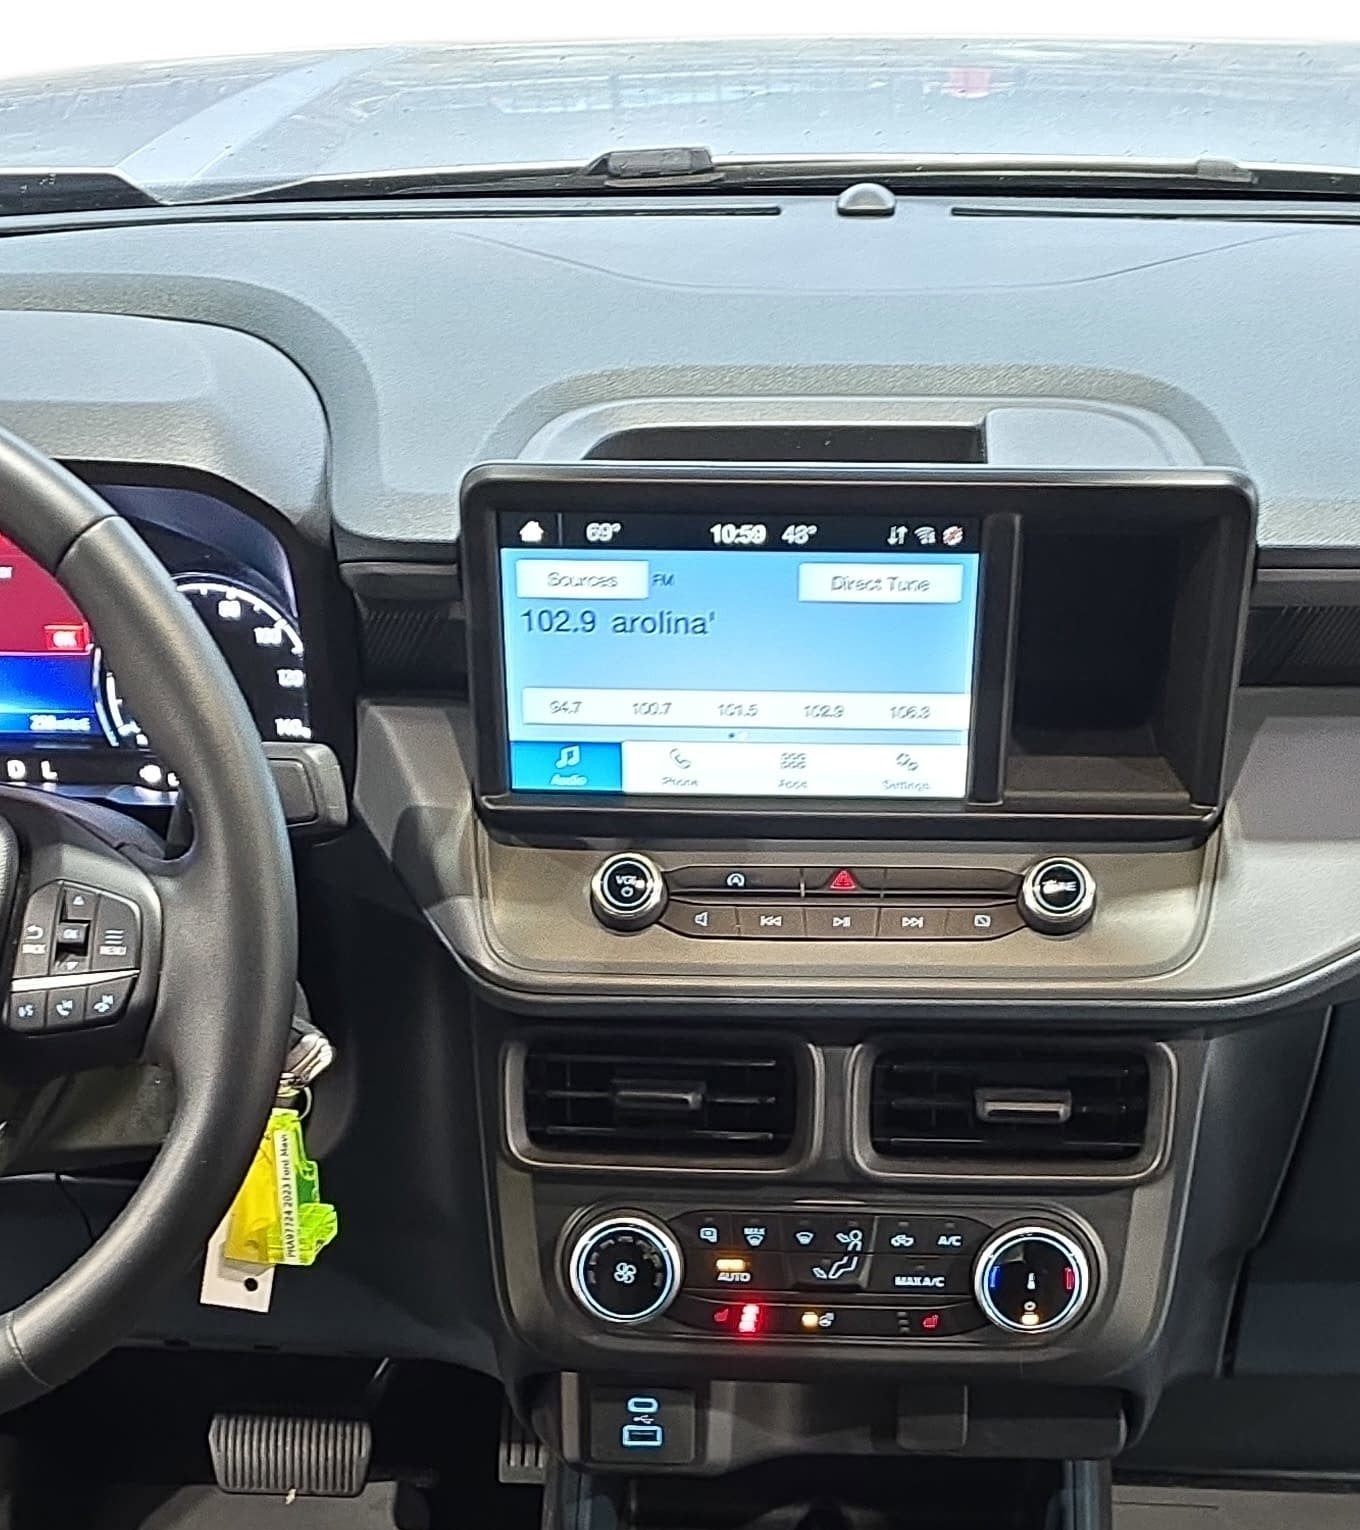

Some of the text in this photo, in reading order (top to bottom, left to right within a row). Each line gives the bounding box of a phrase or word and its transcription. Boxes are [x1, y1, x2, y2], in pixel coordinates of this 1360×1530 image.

[710, 524, 767, 544] 10:59
[547, 571, 618, 589] Sources
[831, 575, 930, 593] Direct Tune
[521, 609, 596, 633] 102.9
[7, 760, 26, 780] D
[40, 761, 58, 780] L
[280, 1160, 291, 1181] Ford
[282, 1184, 292, 1207] 2023
[938, 1236, 962, 1247] A/C
[717, 1272, 752, 1283] AUTO
[895, 1277, 946, 1288] MAX A/C
